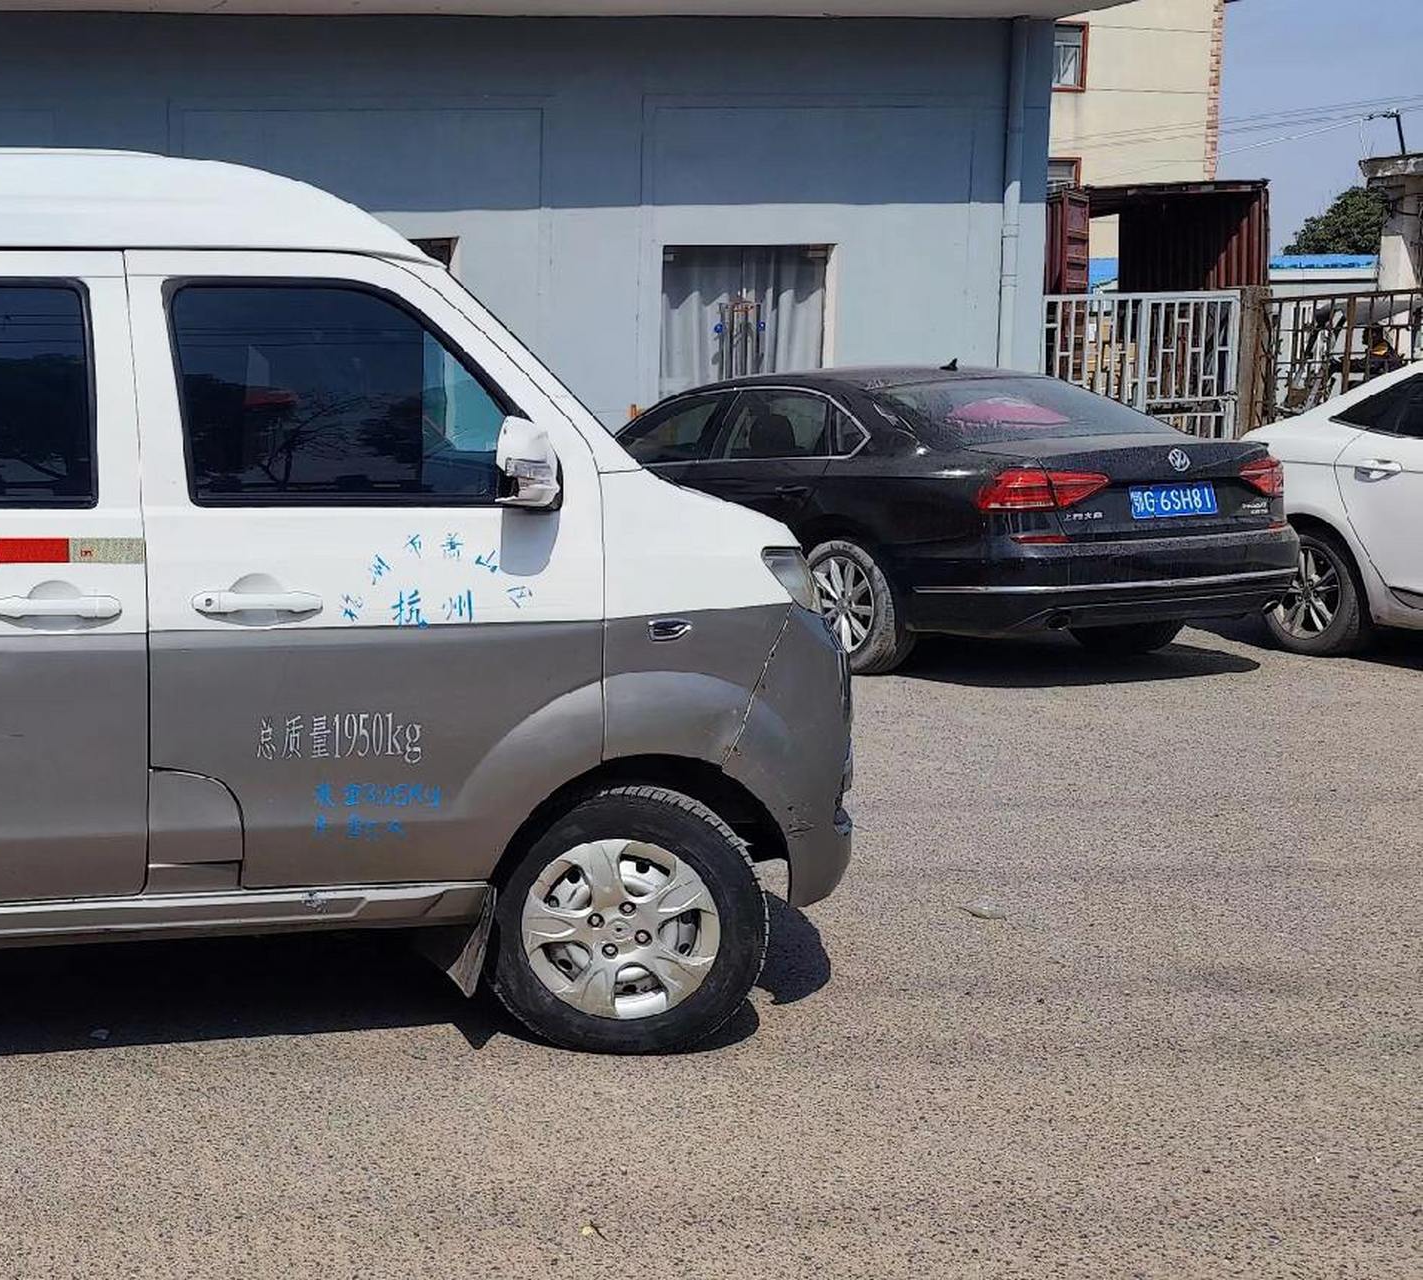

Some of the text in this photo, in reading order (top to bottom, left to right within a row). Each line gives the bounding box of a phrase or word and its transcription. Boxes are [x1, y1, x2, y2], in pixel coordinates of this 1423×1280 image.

[391, 588, 474, 628] 杭州
[256, 712, 423, 764] 总质量1950kg
